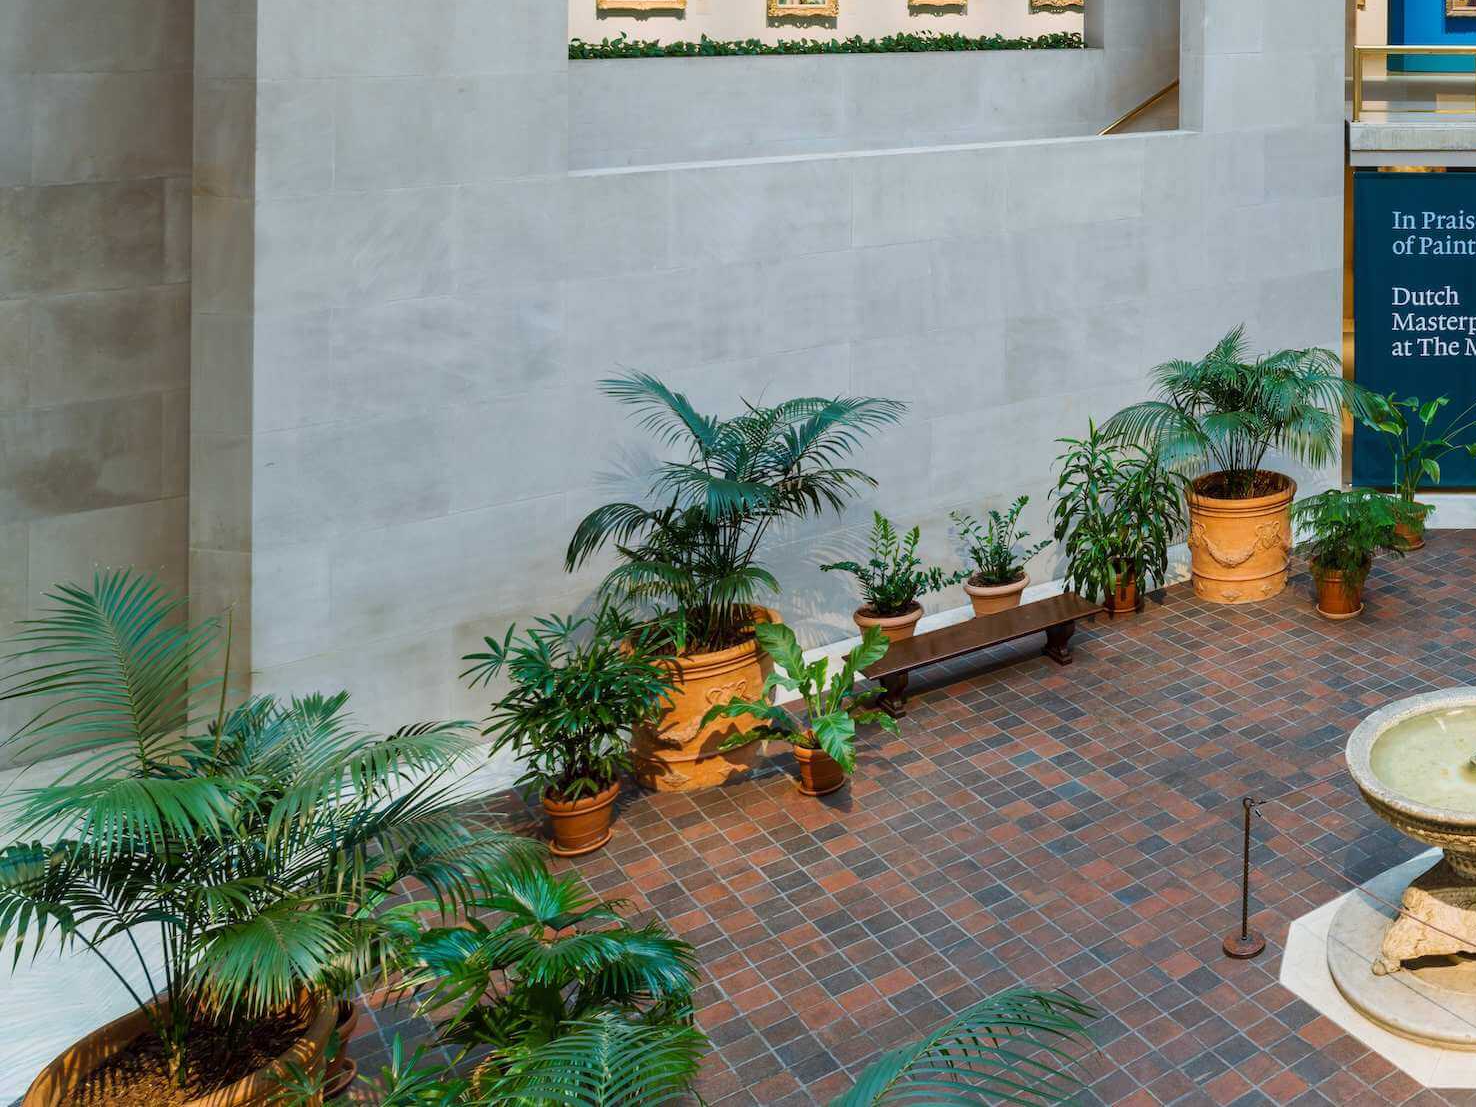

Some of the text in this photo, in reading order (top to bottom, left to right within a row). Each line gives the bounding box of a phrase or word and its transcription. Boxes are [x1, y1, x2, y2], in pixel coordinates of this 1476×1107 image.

[1392, 211, 1416, 230] In
[1392, 235, 1416, 255] of
[1392, 286, 1459, 306] Dutch
[1392, 339, 1412, 357] at
[1417, 337, 1459, 357] The
